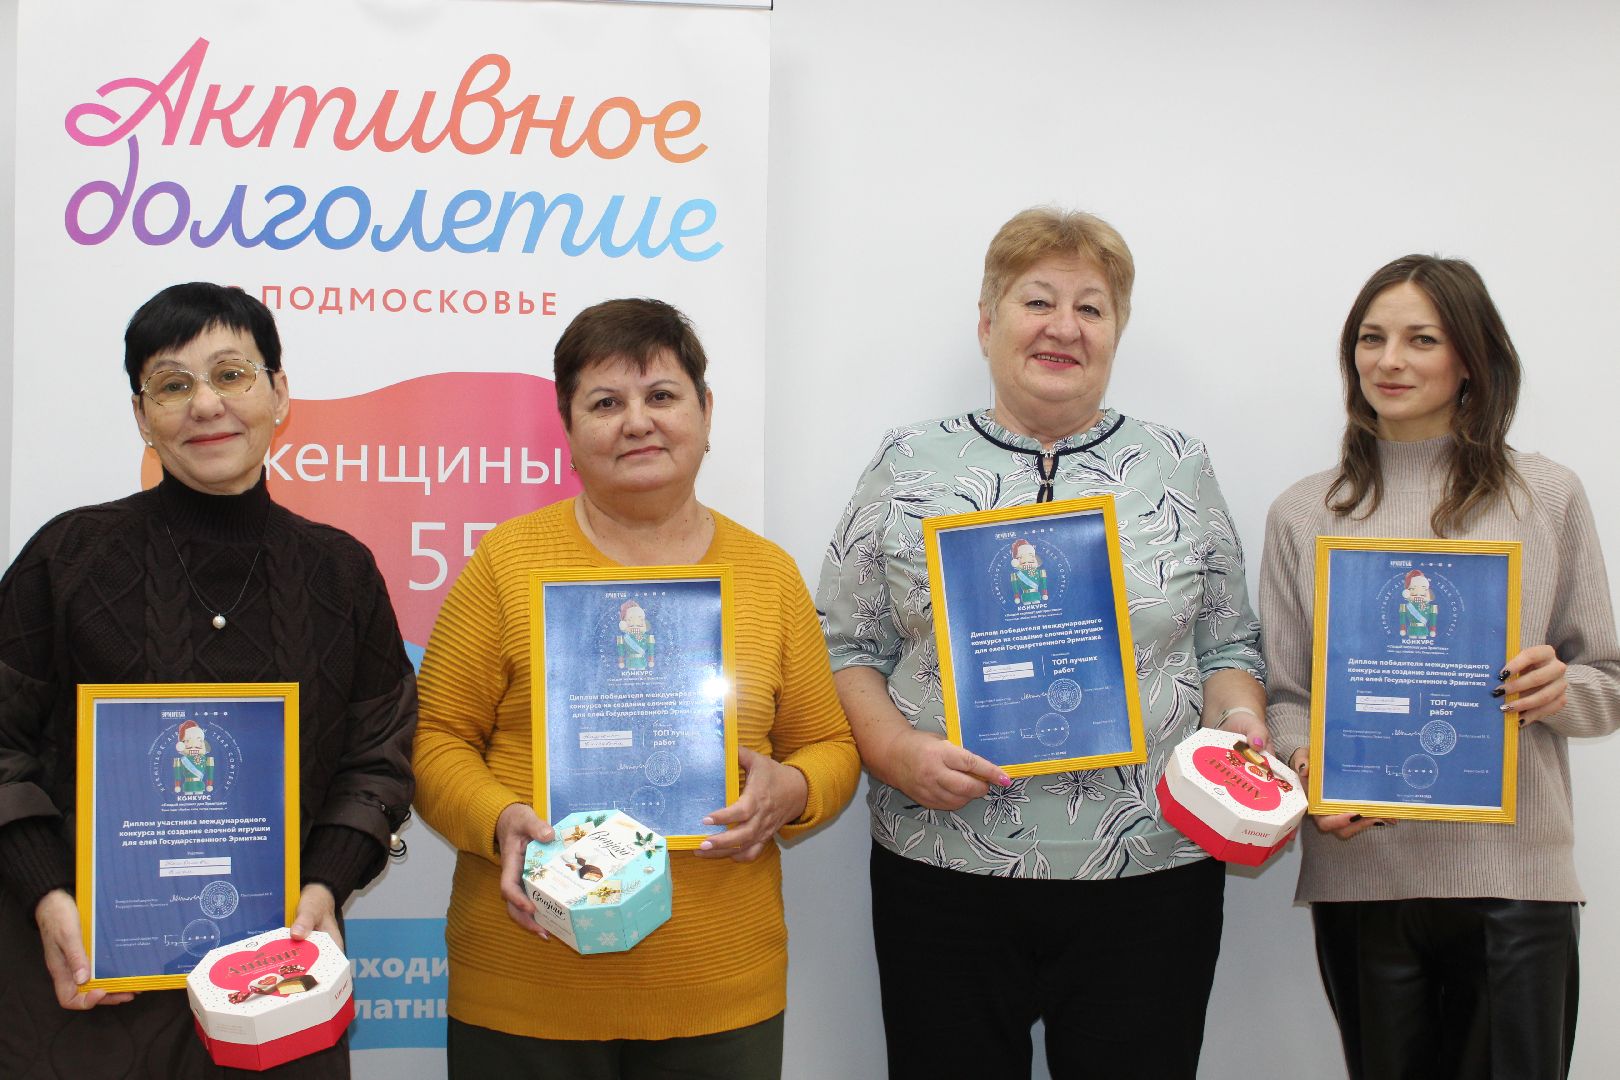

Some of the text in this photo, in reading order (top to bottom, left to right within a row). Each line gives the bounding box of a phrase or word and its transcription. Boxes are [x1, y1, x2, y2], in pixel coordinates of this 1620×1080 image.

[64, 37, 708, 164] Активное
[64, 134, 725, 263] долголетие
[262, 285, 557, 316] ПОДМОСКОВЬЕ
[1000, 625, 1040, 635] победителя
[1042, 618, 1102, 630] международного
[972, 638, 1002, 646] конкурса
[1012, 632, 1042, 642] создание
[1074, 626, 1104, 636] игрушки
[1006, 638, 1066, 651] Государственного
[1066, 634, 1102, 644] Эрмитажа
[1069, 655, 1098, 665] лучших
[1348, 658, 1490, 670] Диплом победителя международного
[1054, 667, 1075, 676] работ
[1392, 668, 1424, 676] создание
[1384, 676, 1448, 686] Государственного
[1449, 679, 1486, 687] Эрмитажа
[600, 693, 644, 701] победителя
[606, 710, 668, 718] Государственного
[1430, 708, 1453, 716] работ
[653, 740, 676, 748] работ
[122, 817, 267, 828] Диплом участника международного
[119, 829, 156, 837] конкурса
[159, 836, 227, 846] Государственного
